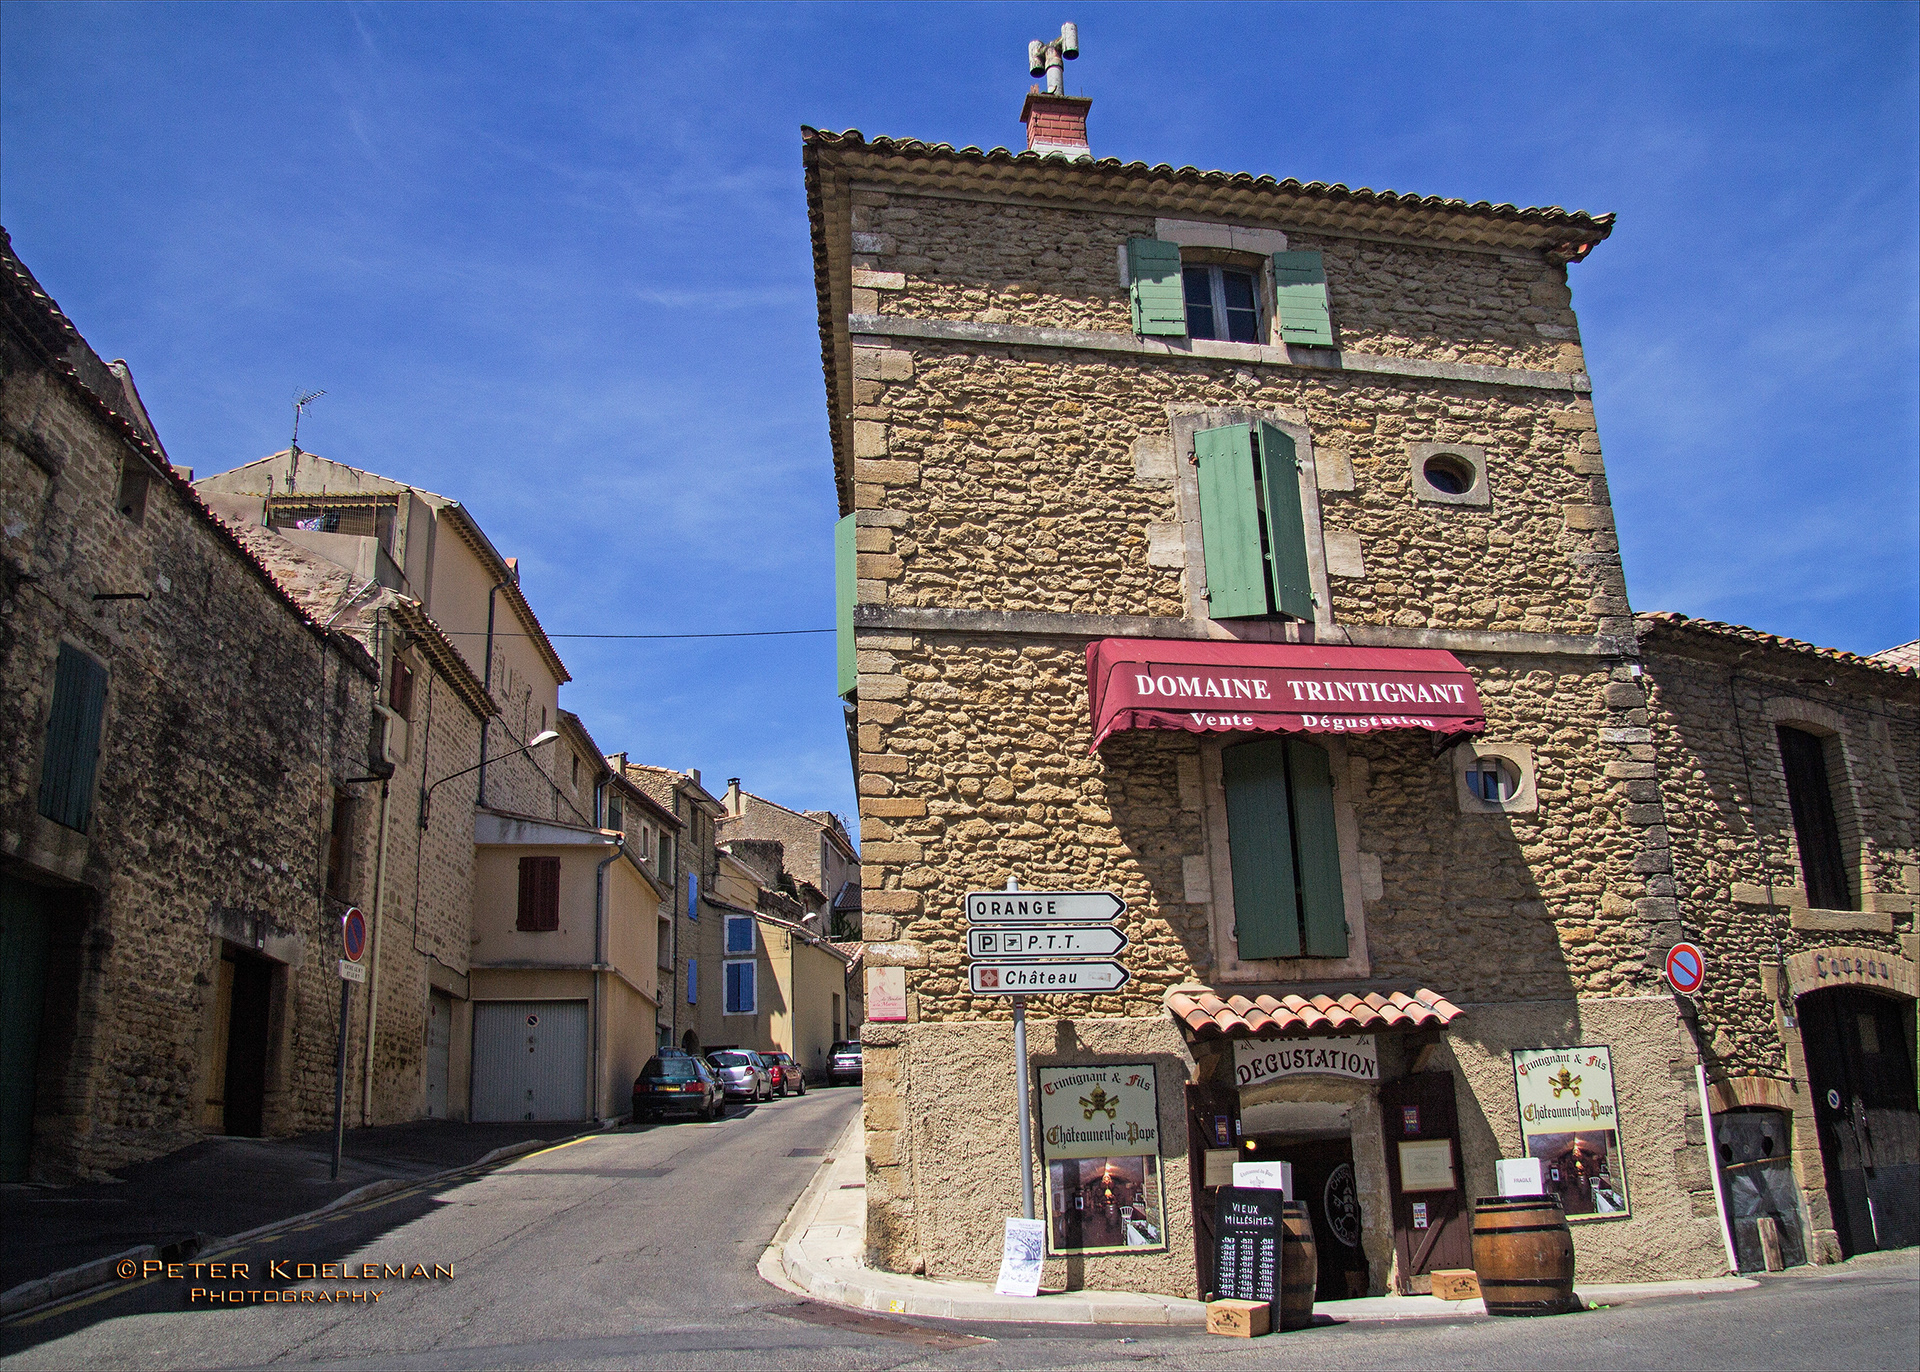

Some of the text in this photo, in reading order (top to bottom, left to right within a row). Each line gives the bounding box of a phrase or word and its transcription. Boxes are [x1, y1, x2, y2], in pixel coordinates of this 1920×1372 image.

[1135, 675, 1465, 704] DOMAINE TRINTIGNANT
[1190, 712, 1436, 731] Vente Dégustation
[976, 901, 1056, 915] ORANGE
[1028, 935, 1080, 949] P.T.T.
[1816, 954, 1888, 979] Caveau
[1005, 970, 1077, 985] Château
[1237, 1049, 1375, 1084] DEGUSTATION
[1517, 1054, 1607, 1075] Trintignant & Fils
[1043, 1072, 1152, 1095] Trintignant & Fils
[1232, 1202, 1258, 1214] VIEUX
